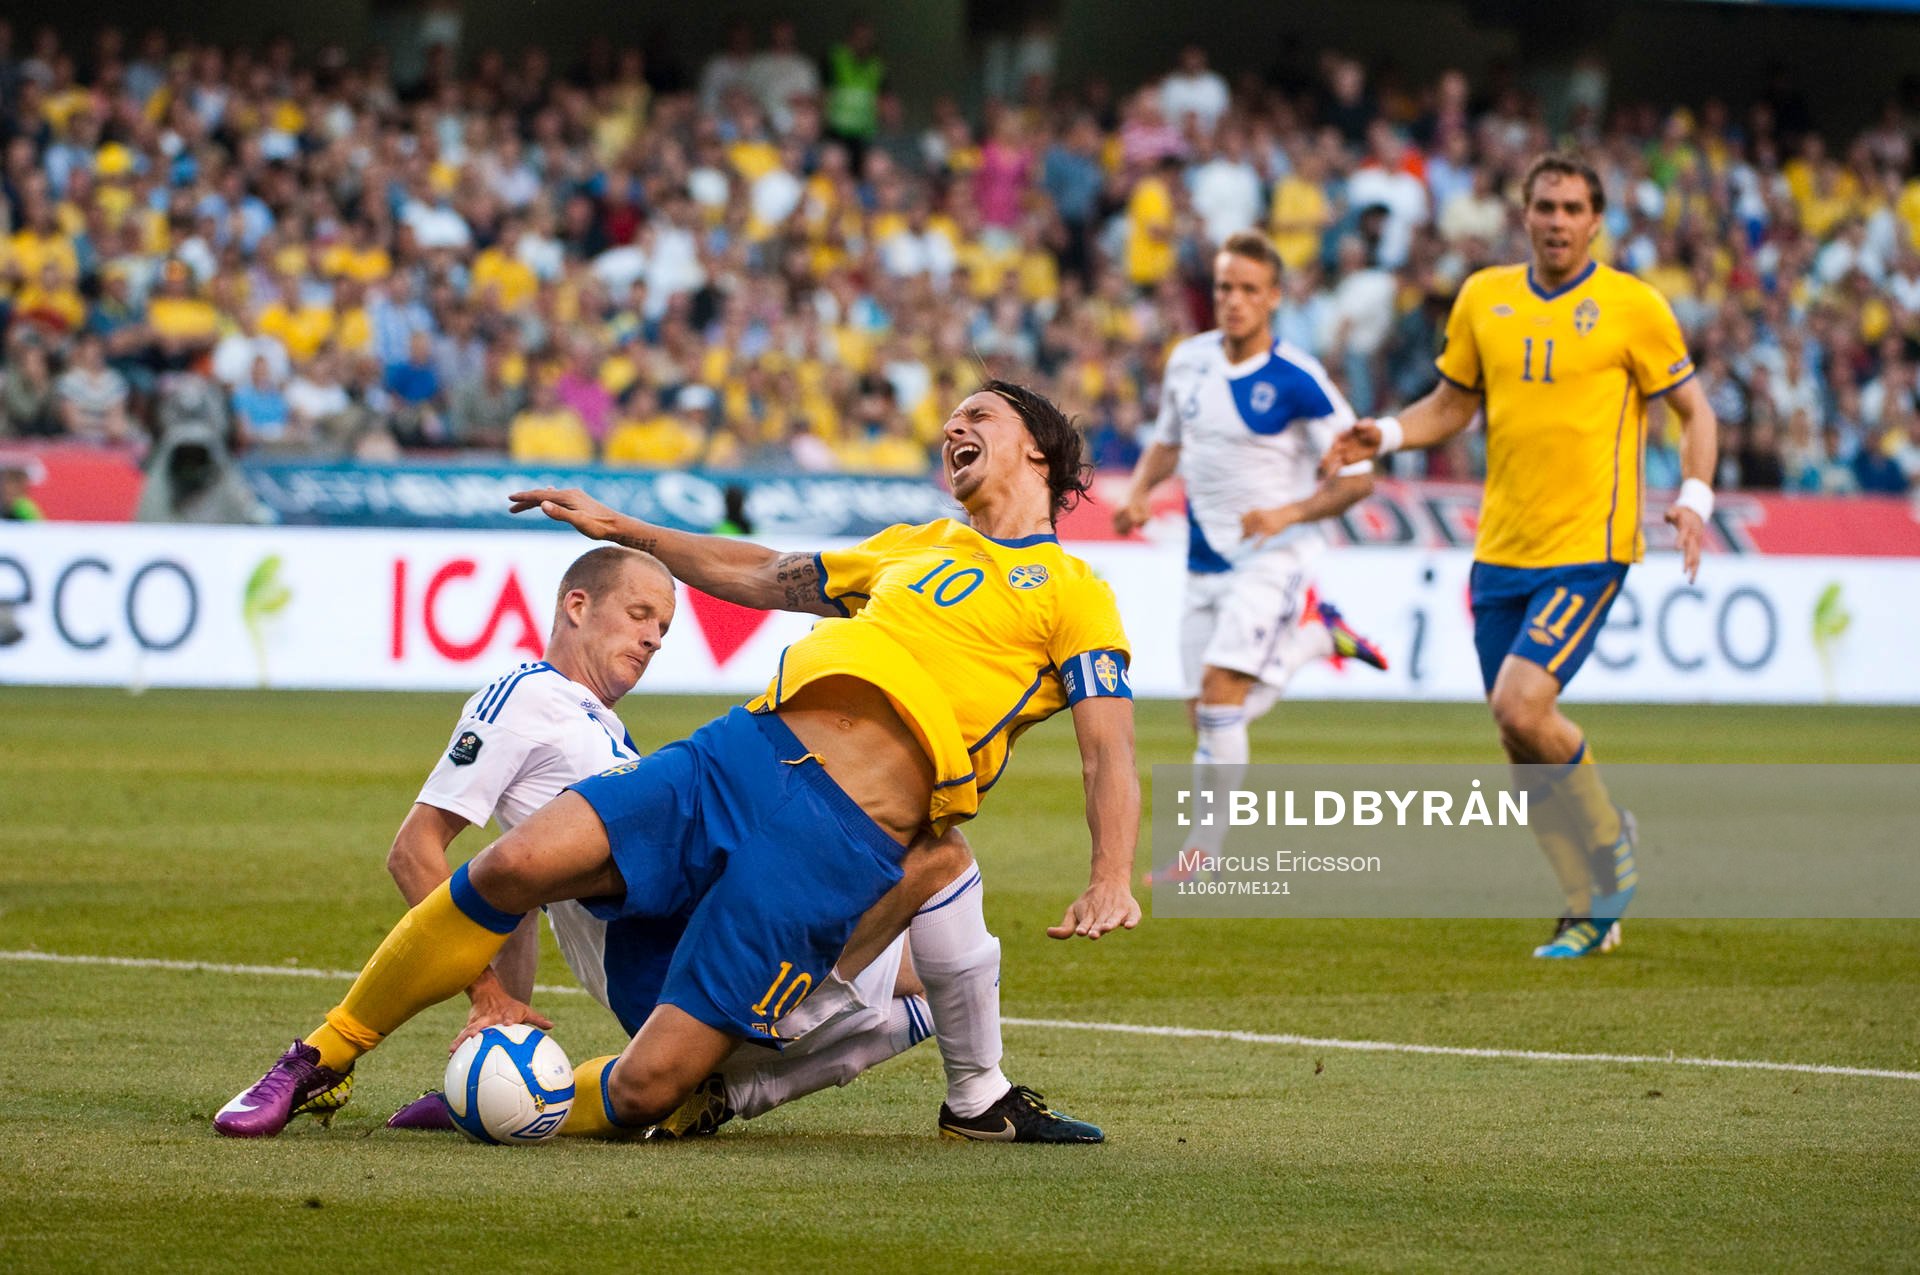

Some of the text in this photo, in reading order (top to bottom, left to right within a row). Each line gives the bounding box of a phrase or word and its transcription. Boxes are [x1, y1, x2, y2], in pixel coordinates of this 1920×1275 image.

[1520, 337, 1556, 384] 11
[907, 559, 984, 607] 10
[391, 559, 546, 662] ICA
[1532, 586, 1585, 640] 11
[751, 961, 812, 1020] 10
